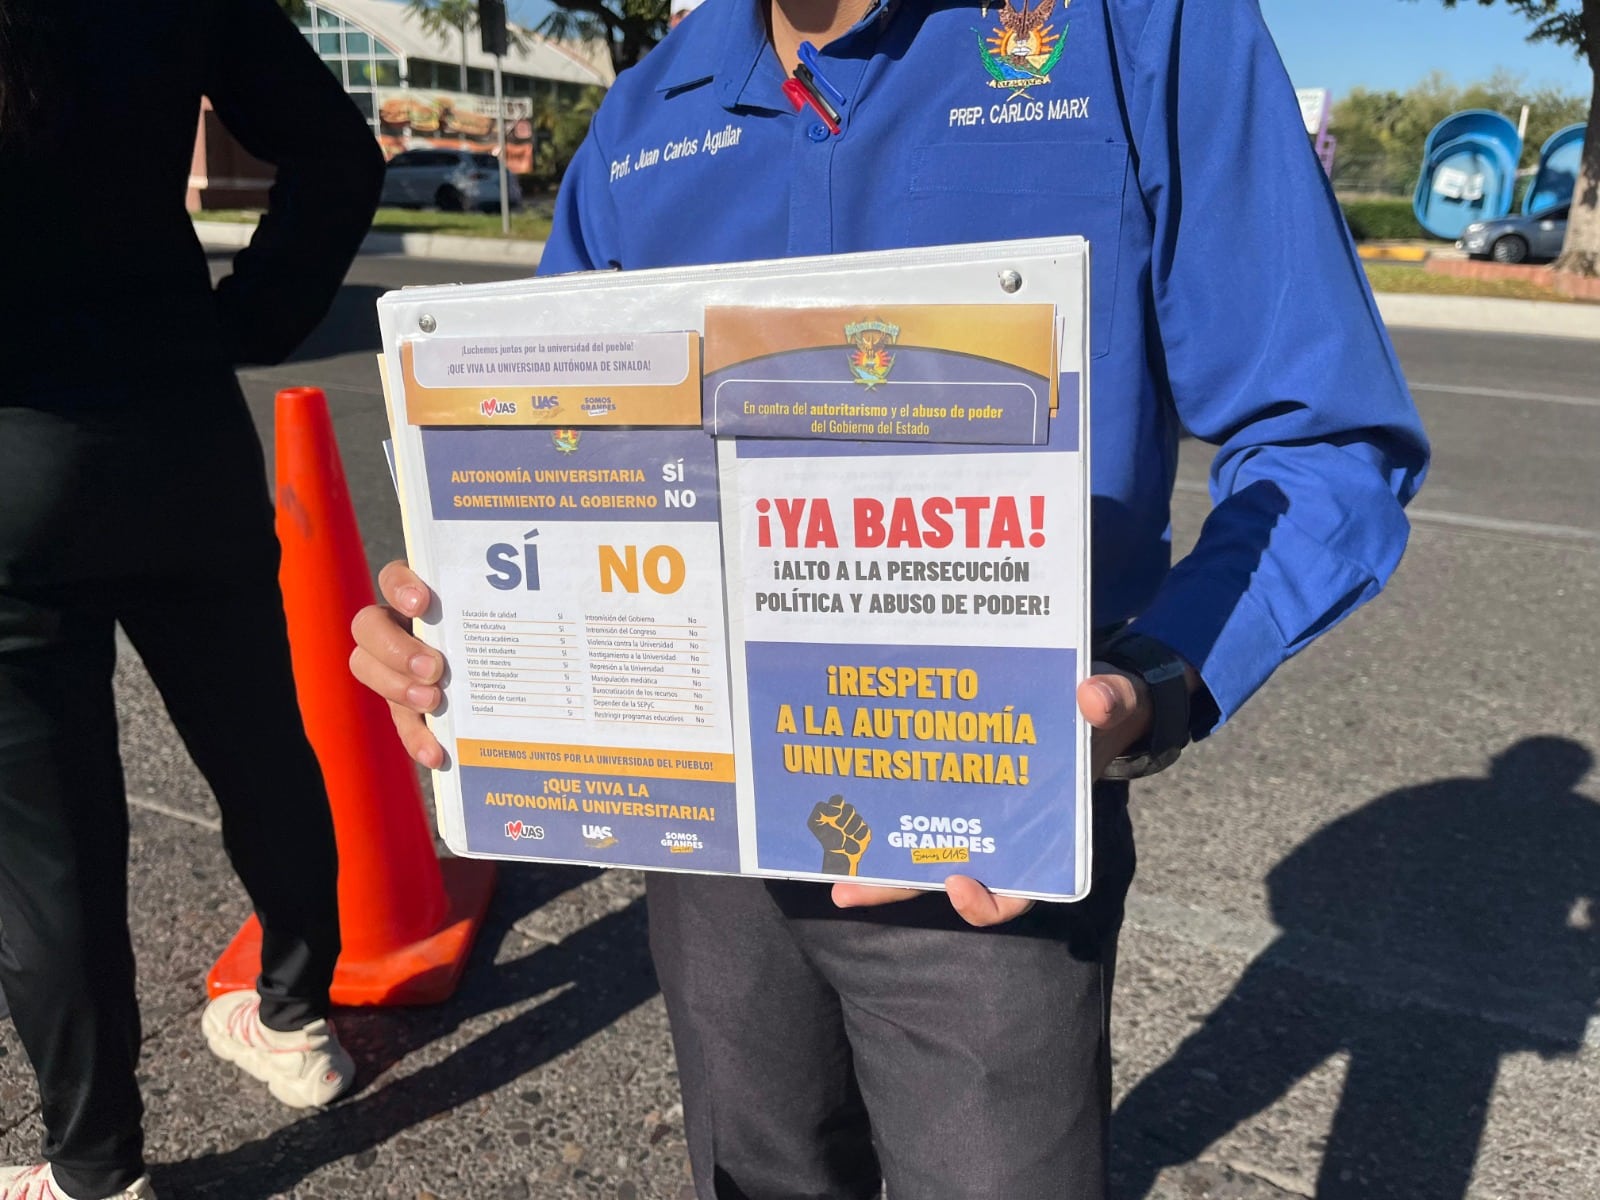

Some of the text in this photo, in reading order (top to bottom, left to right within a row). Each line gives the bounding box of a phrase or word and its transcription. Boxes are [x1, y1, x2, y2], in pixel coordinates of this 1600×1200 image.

[949, 97, 1090, 127] PREP. CARLOS MARX
[610, 124, 743, 183] Prof. Juan Carlos Aguilar
[461, 341, 634, 357] ¡Luchemos juntos por la universidad del pueblo!
[447, 359, 652, 375] ¡QUE VIVA LA UNIVERSIDAD AUTÓNOMA DE SINALOA!
[531, 395, 560, 409] UAS
[743, 401, 1004, 421] En contra del autoritarismo y el abuso de poder
[810, 420, 930, 435] del Gobierno del Estado
[451, 458, 684, 484] AUTONOMÍA UNIVERSITARIA SÍ
[453, 489, 697, 508] SOMETIMIENTO AL GOBIERNO NO
[755, 495, 1046, 549] ¡YA BASTA!
[485, 527, 686, 595] SÍ NO
[773, 556, 1030, 582] ¡ALTO A LA PERSECUCIÓN
[755, 587, 1050, 616] POLÍTICA Y ABUSO DE PODER!
[489, 610, 496, 618] de
[619, 627, 628, 635] del
[629, 628, 657, 636] Congreso
[639, 640, 674, 649] Universidad
[635, 688, 644, 696] de
[826, 664, 979, 701] ¡RESPETO
[776, 703, 1037, 746] A LA AUTONOMÍA
[479, 747, 714, 771] ¡LUCHEMOS JUNTOS POR LA UNIVERSIDAD DEL PUEBLO!
[783, 743, 1030, 787] UNIVERSITARIA!
[543, 778, 649, 798] ¡QUE VIVA LA
[484, 791, 715, 821] AUTONOMÍA UNIVERSITARIA!
[582, 824, 613, 840] UAS
[899, 814, 982, 835] SOMOS
[660, 839, 704, 849] GRANDES
[665, 831, 698, 841] SOMOS
[887, 831, 996, 854] GRANDES
